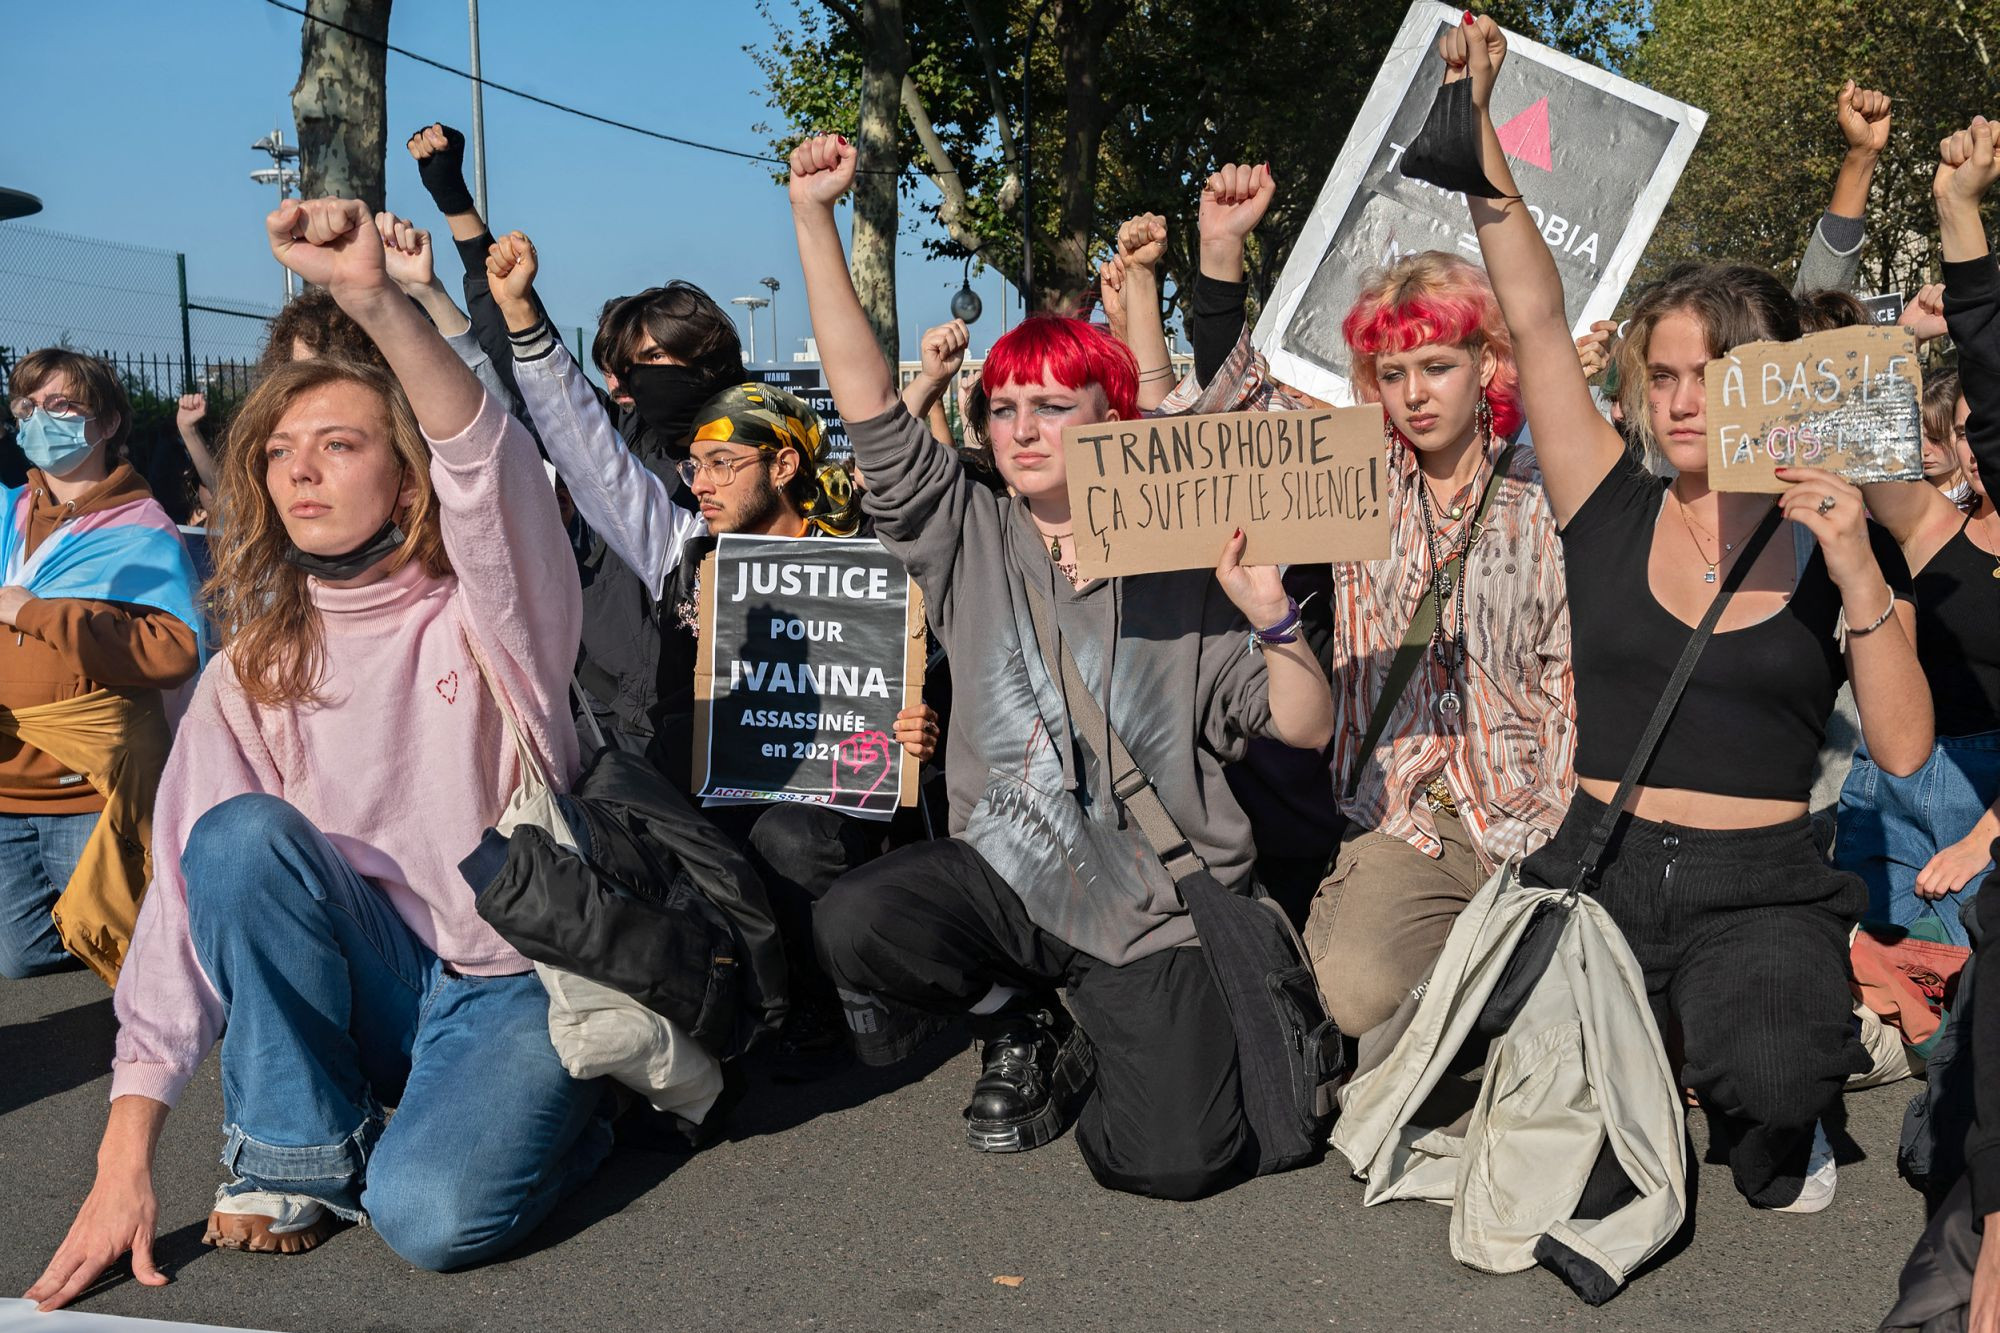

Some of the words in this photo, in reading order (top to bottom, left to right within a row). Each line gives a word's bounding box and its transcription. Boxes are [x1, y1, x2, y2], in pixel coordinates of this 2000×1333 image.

[764, 372, 790, 382] IVANNA
[1722, 355, 1747, 408] À
[1761, 358, 1841, 406] BAS
[1863, 354, 1909, 405] LE
[1077, 414, 1334, 477] TRANSPHOBIE
[1087, 485, 1128, 563] ÇA
[1137, 473, 1240, 530] SUFFIT
[1249, 473, 1271, 521] LE
[1281, 457, 1380, 521] SILENCE!
[731, 562, 888, 601] JUSTICE
[770, 618, 844, 642] POUR
[730, 660, 889, 699] IVANNA
[740, 709, 865, 732] ASSASSINÉE
[761, 743, 787, 758] en
[791, 743, 840, 761] 2021
